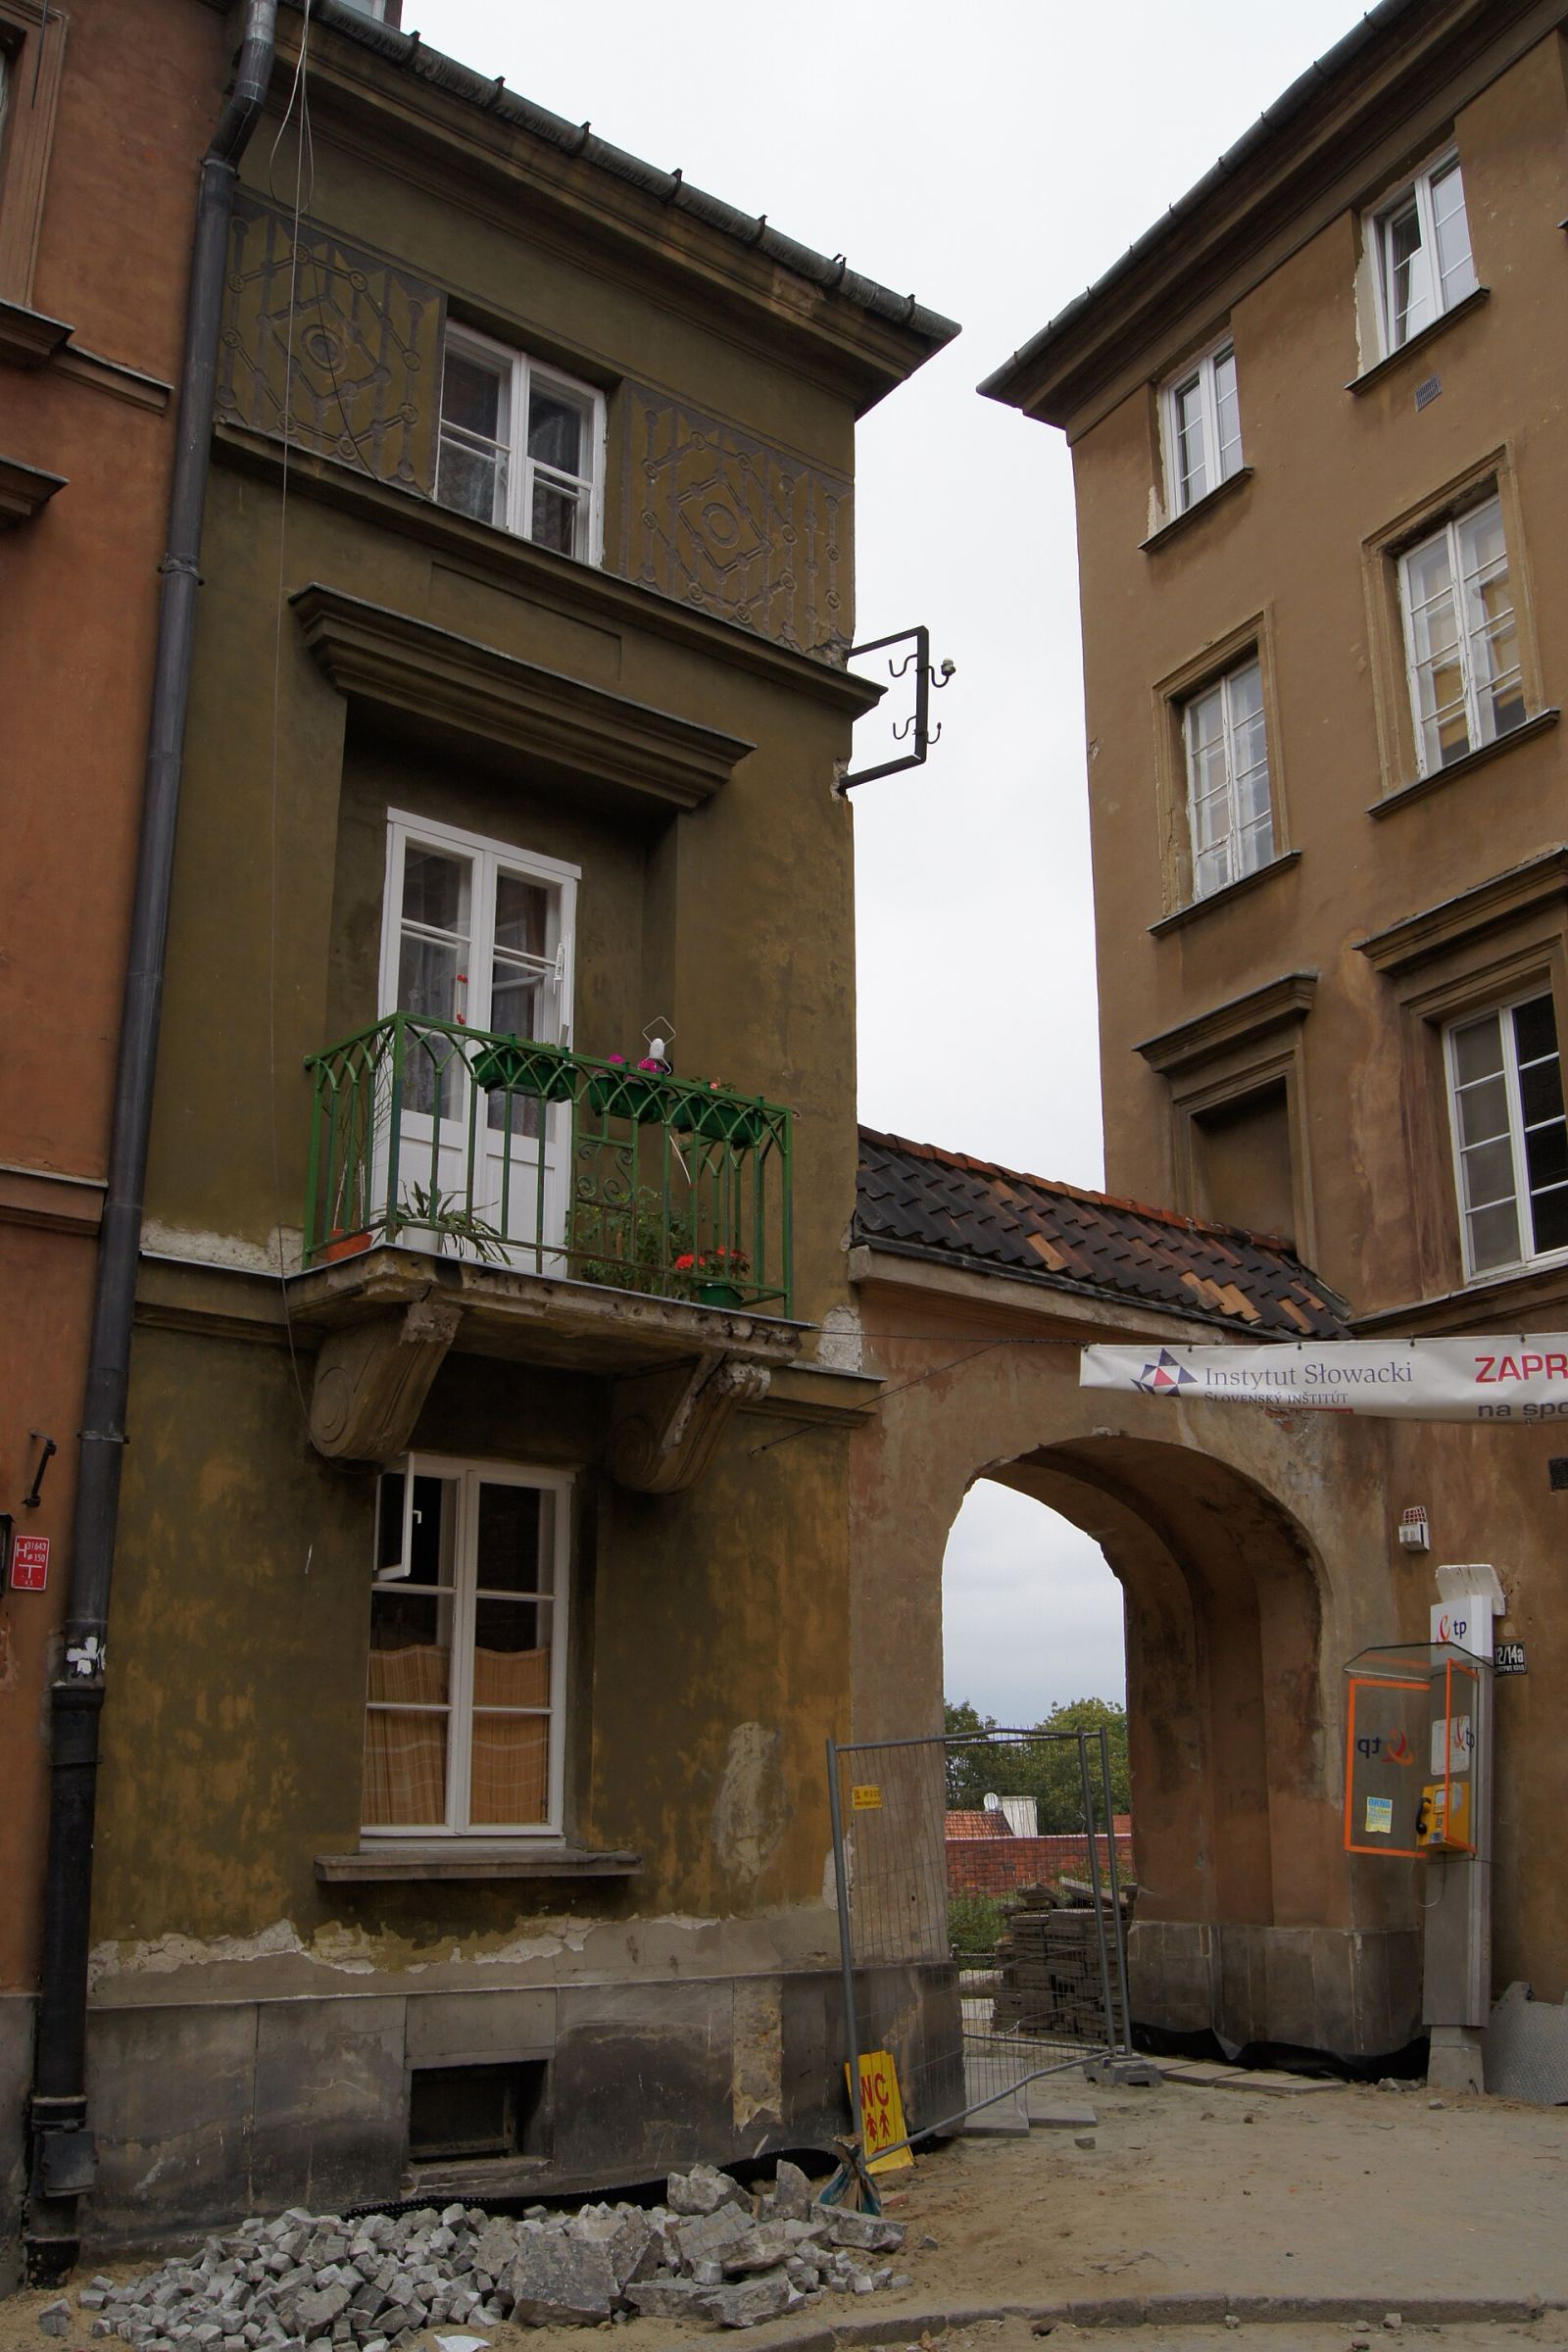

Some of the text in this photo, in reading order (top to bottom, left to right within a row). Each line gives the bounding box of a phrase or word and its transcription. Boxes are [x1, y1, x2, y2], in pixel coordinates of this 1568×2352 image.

[1205, 1361, 1413, 1391] Instytut Słowacki
[1475, 1353, 1568, 1383] ZAPR
[1478, 1404, 1511, 1417] na
[1453, 1620, 1467, 1640] tp
